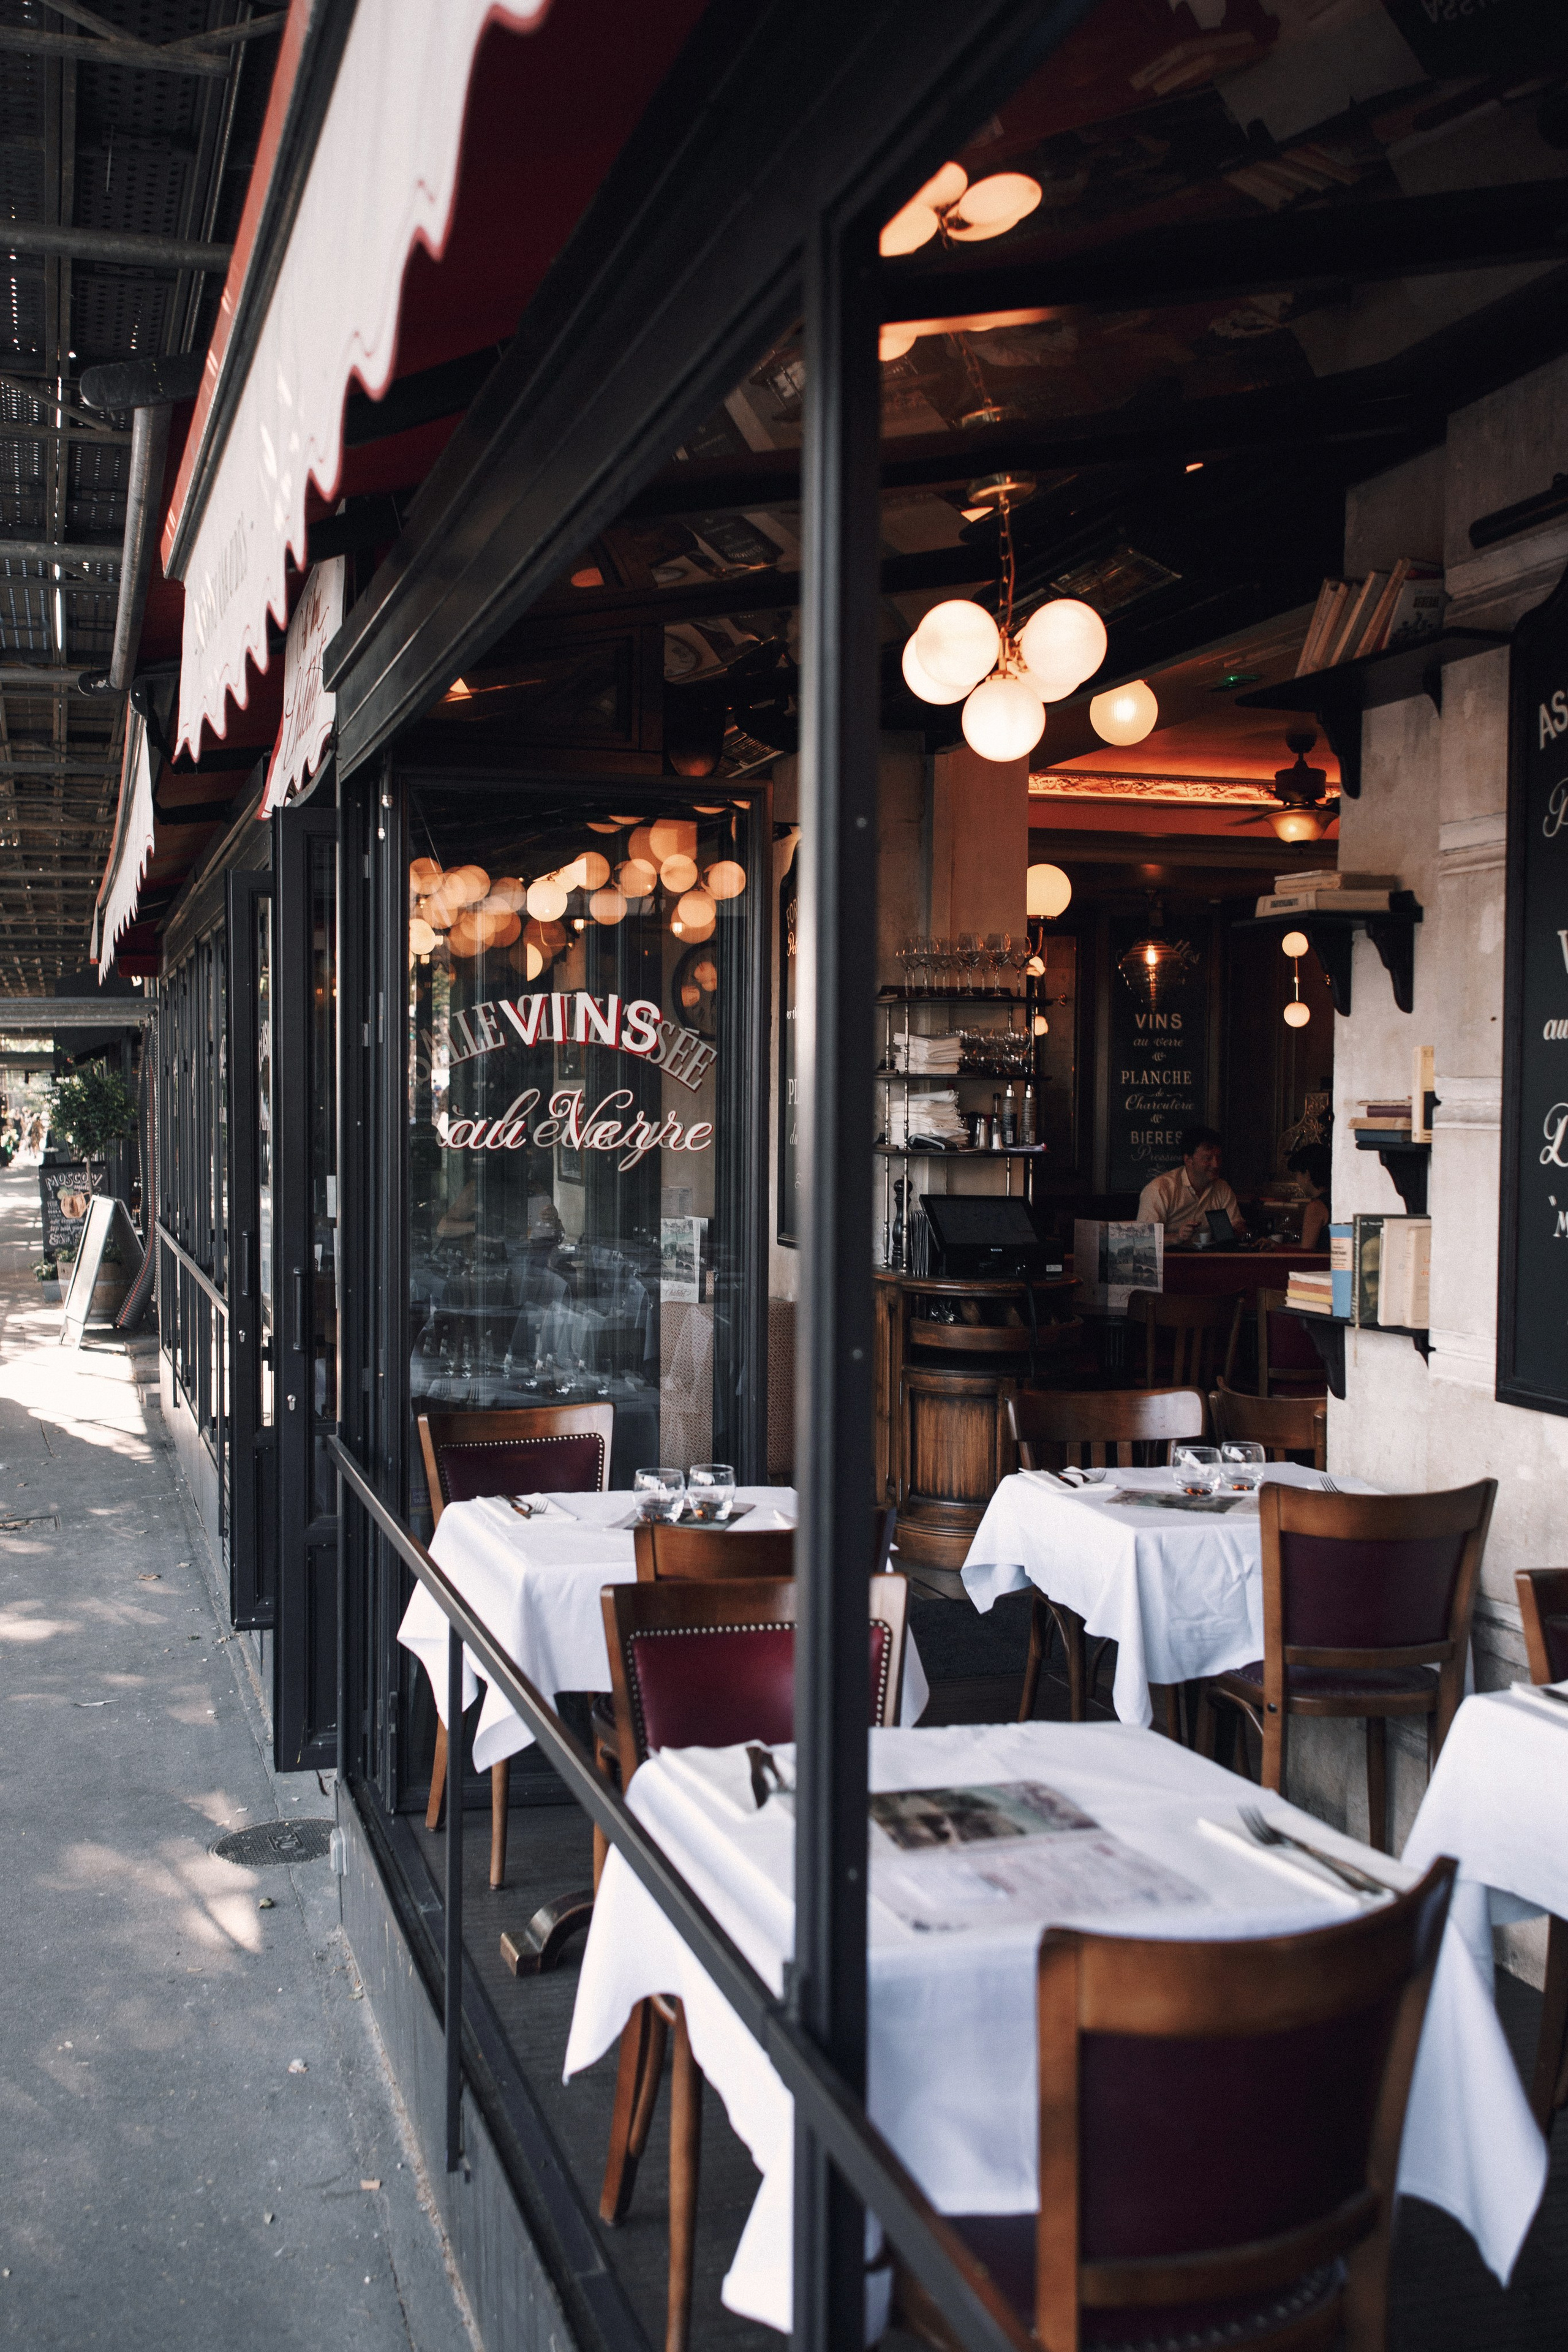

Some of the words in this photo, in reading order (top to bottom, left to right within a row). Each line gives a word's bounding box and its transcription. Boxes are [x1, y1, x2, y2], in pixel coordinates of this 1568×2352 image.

[498, 992, 663, 1055] VINS
[1135, 1013, 1183, 1030] VINS
[1134, 1038, 1149, 1047] au
[1154, 1037, 1183, 1047] verre
[1120, 1070, 1192, 1085] PLANCHE
[1125, 1093, 1194, 1110] Charcuterie
[548, 1088, 714, 1152] Verre
[45, 1172, 103, 1191] MOSCOW
